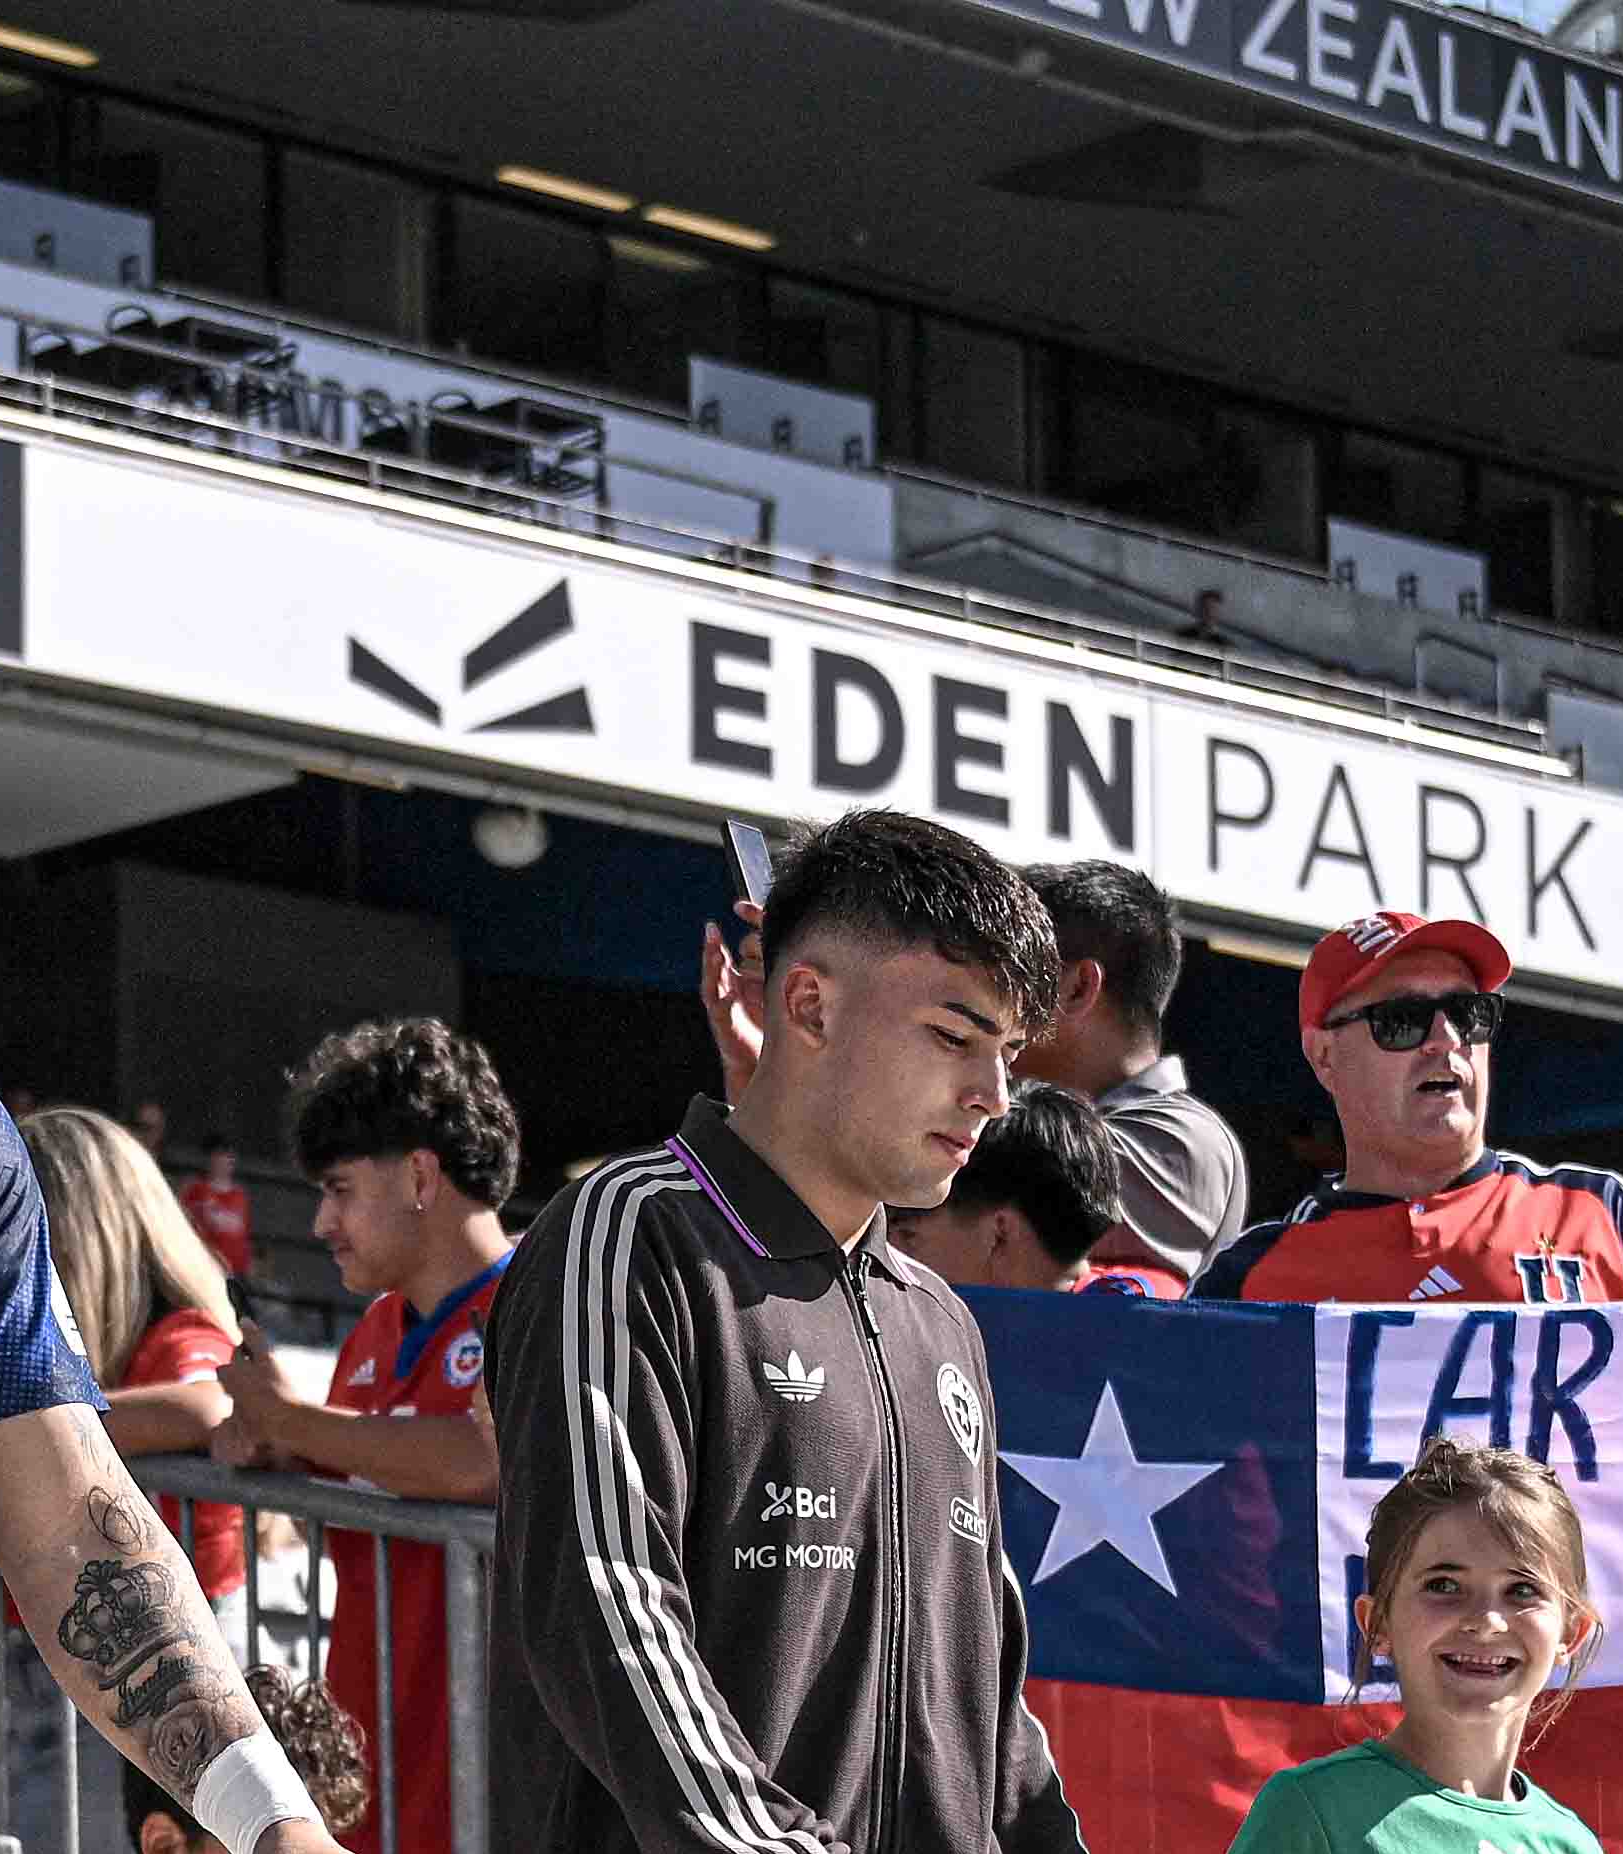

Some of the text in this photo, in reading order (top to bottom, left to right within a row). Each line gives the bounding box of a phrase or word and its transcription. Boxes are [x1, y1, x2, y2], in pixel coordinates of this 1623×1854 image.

[689, 620, 1600, 947] EDEN PARK
[795, 1486, 836, 1519] Bci
[735, 1544, 855, 1570] MG MOTOR
